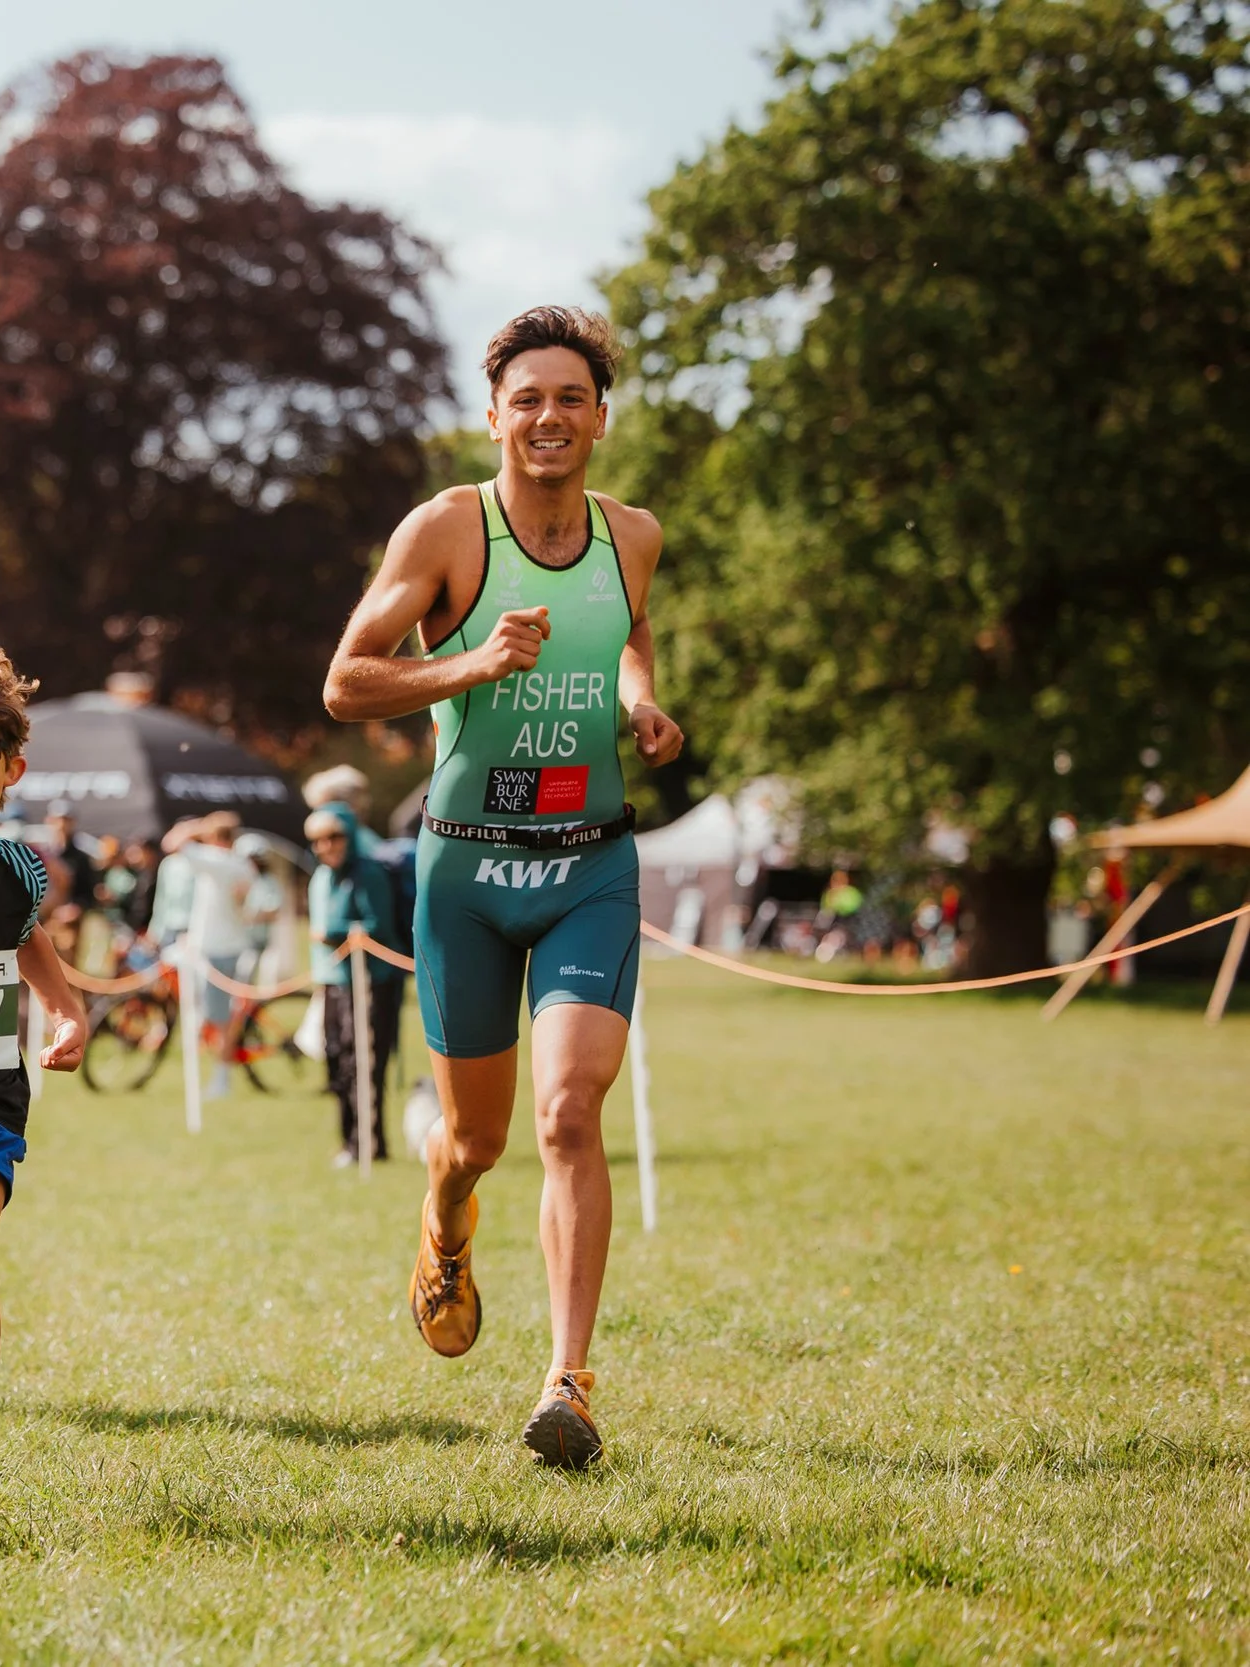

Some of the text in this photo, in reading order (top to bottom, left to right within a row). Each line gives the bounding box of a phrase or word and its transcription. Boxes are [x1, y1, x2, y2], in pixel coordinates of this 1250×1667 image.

[492, 672, 605, 711] FISHER
[510, 720, 578, 758] AUS
[496, 784, 528, 798] BUR
[474, 855, 581, 889] KWT
